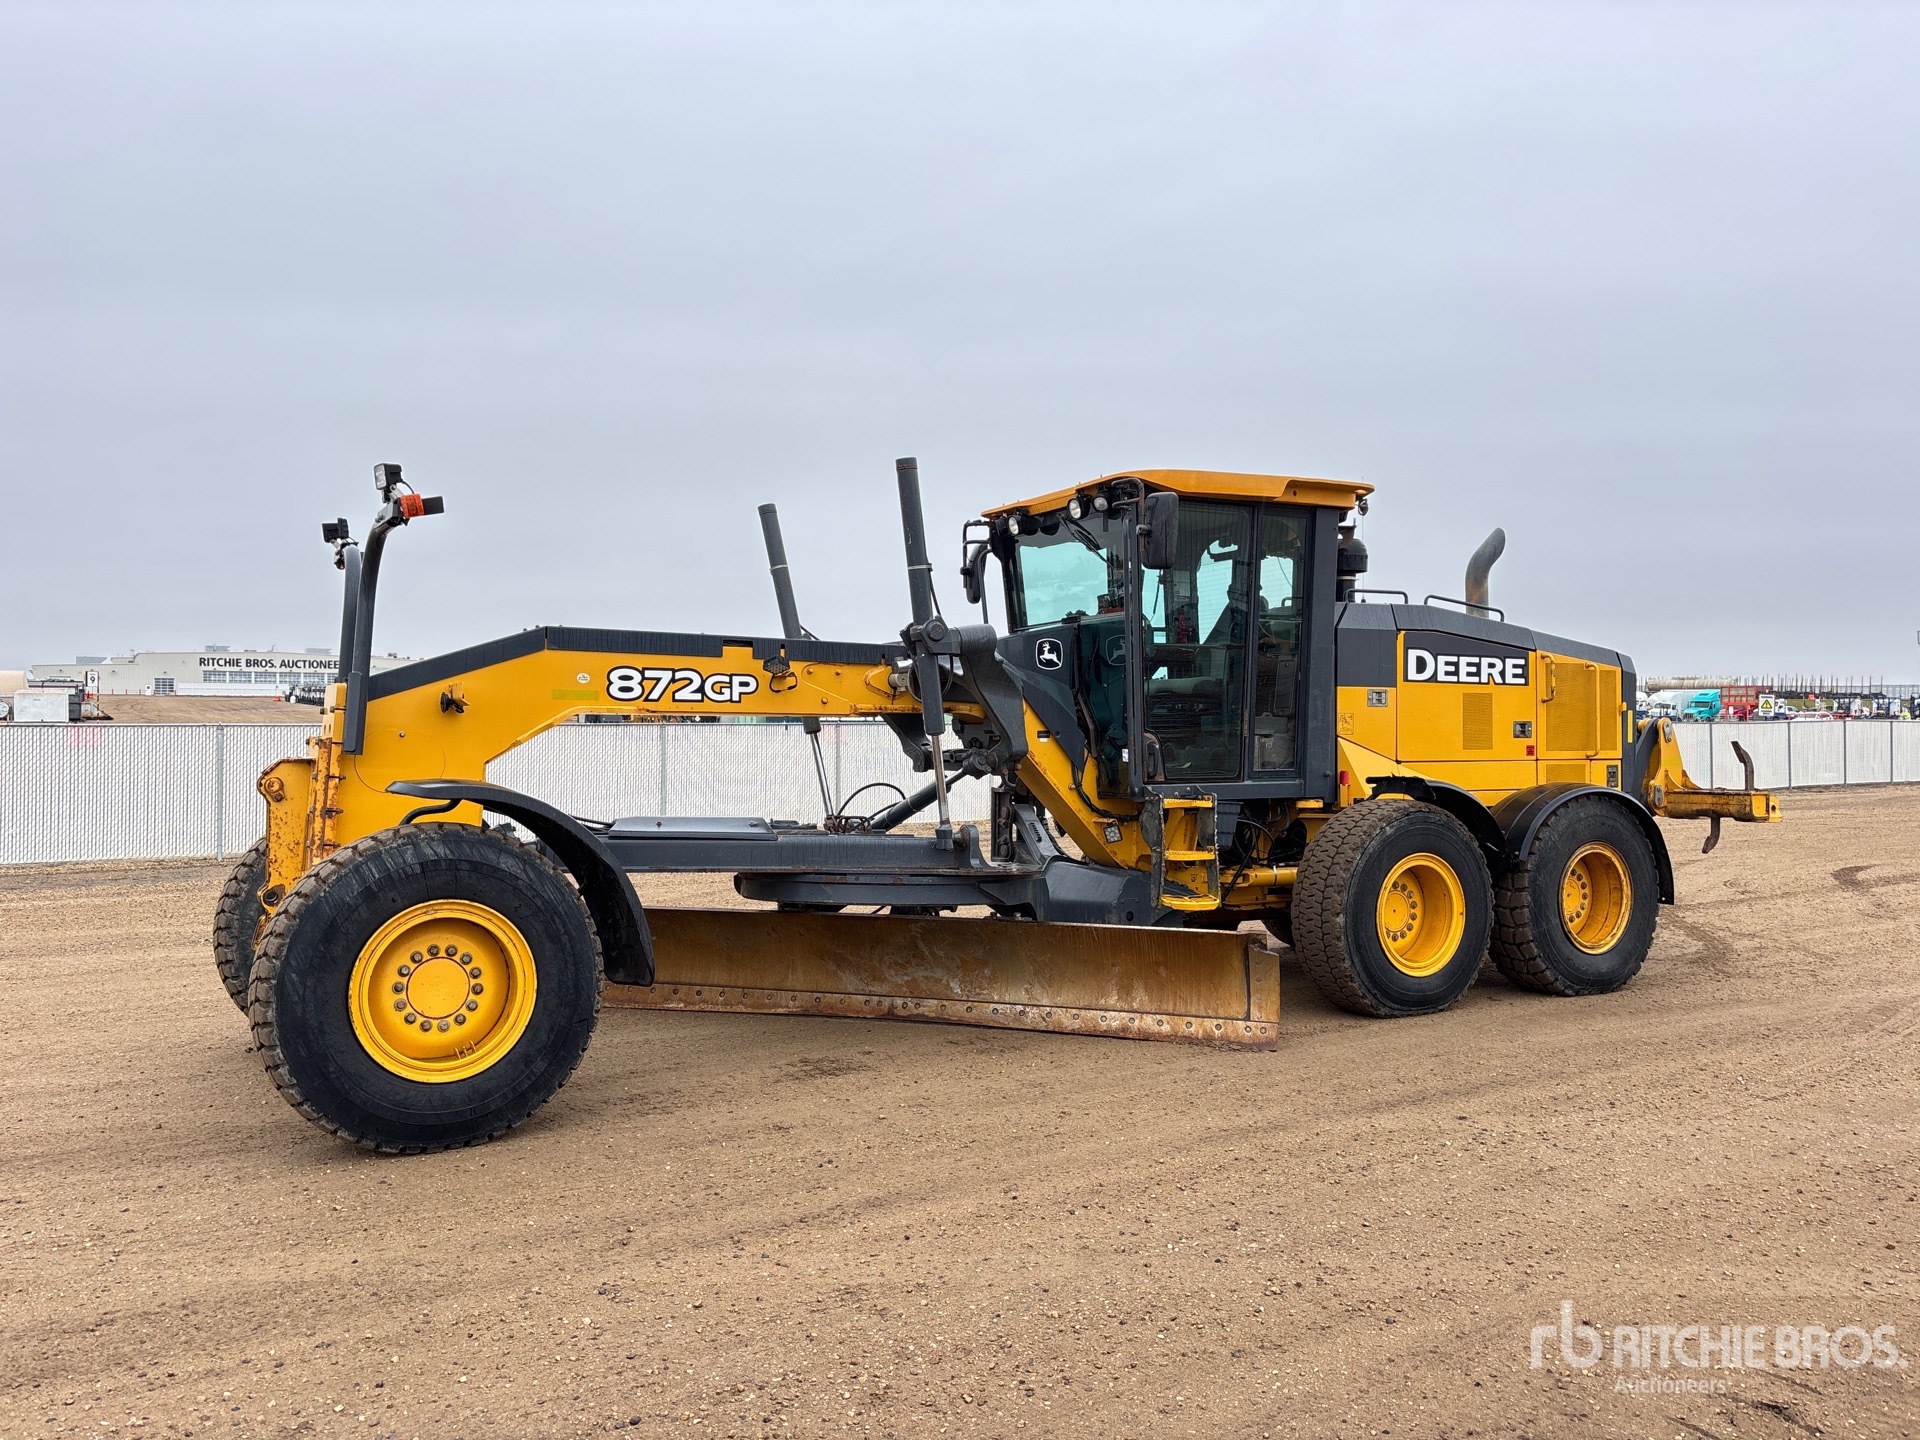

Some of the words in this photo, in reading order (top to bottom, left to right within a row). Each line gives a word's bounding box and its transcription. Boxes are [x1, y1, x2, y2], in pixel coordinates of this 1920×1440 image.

[199, 657, 242, 668] RITCHIE
[245, 659, 277, 669] BROS.
[279, 659, 339, 670] AUCTIONEE
[1407, 648, 1525, 684] DEERE
[607, 666, 759, 703] 872GP
